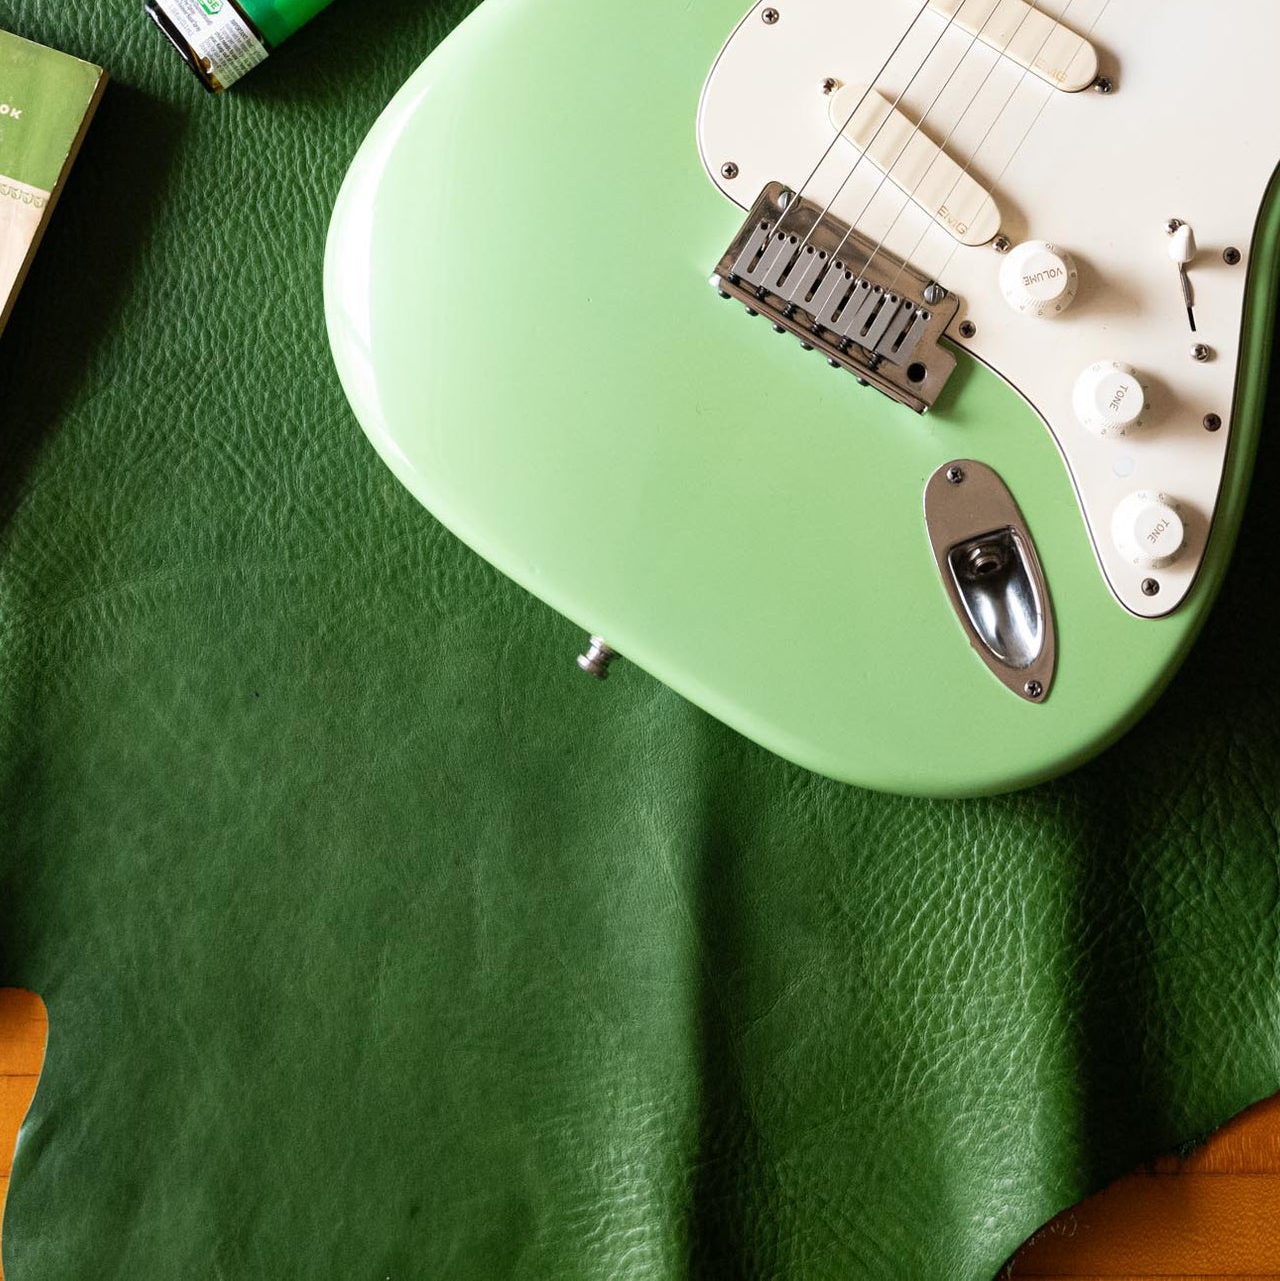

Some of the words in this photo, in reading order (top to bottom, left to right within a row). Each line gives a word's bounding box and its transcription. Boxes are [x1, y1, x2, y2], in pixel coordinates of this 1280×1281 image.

[1022, 267, 1063, 286] VOLUME
[1109, 385, 1129, 412] TONE
[1146, 518, 1170, 544] TONE
